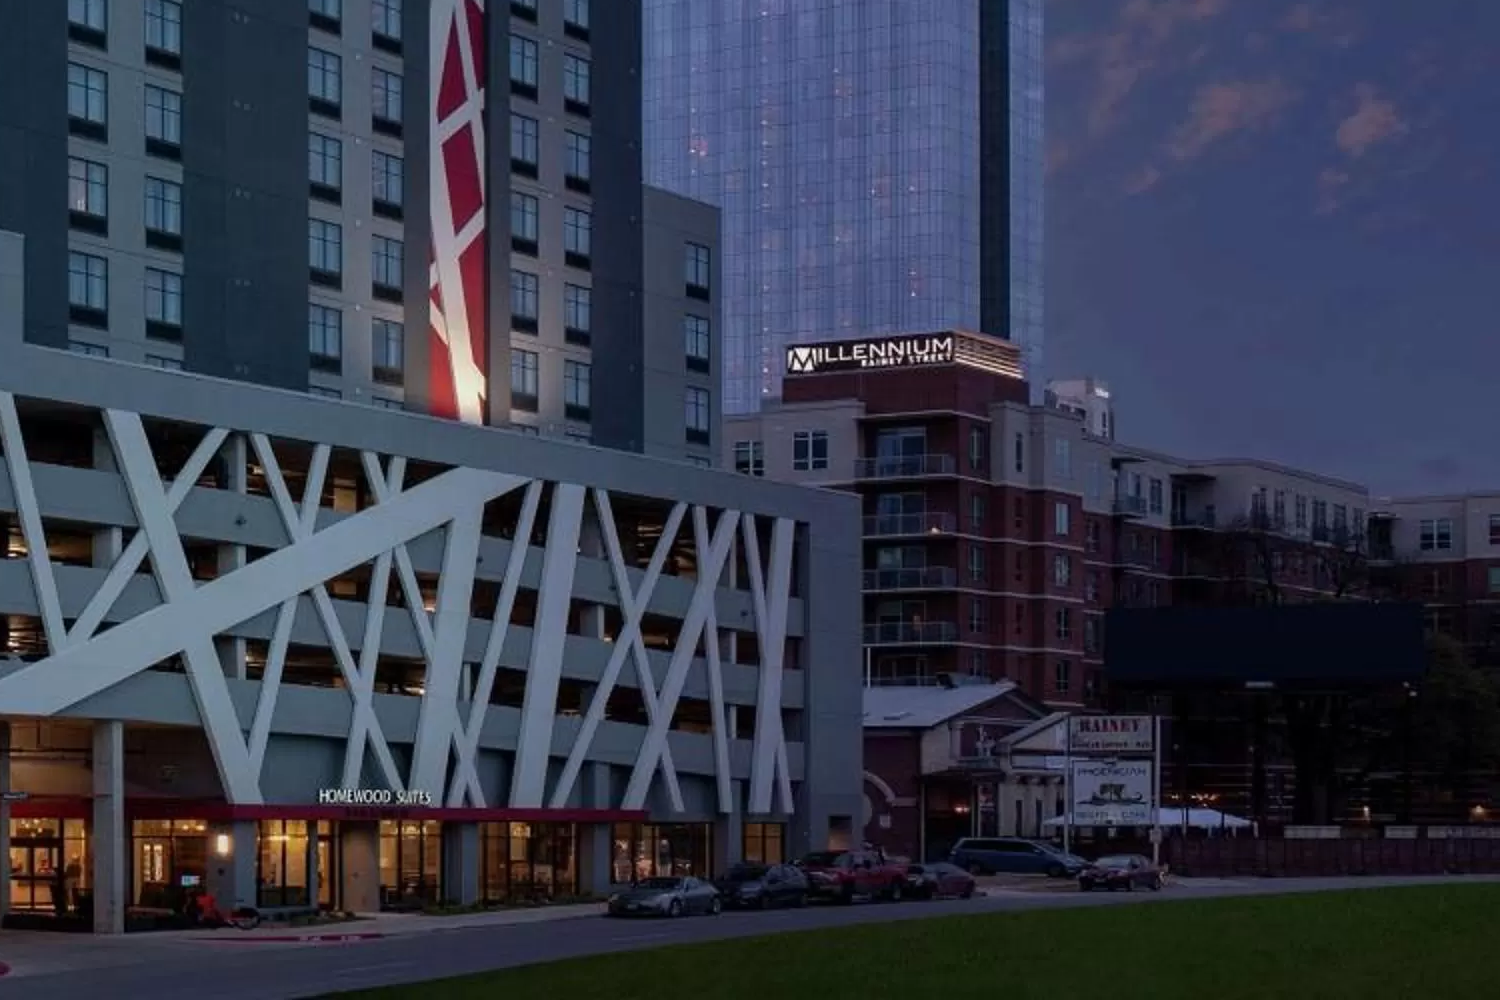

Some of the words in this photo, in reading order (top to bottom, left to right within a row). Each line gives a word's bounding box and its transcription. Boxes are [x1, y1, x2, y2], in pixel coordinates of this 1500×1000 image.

[787, 337, 953, 371] MILLENNIUM
[908, 352, 952, 365] STREET
[1079, 717, 1141, 733] RAINEY
[319, 788, 391, 803] HOMEWOOD
[395, 789, 432, 805] SUITES
